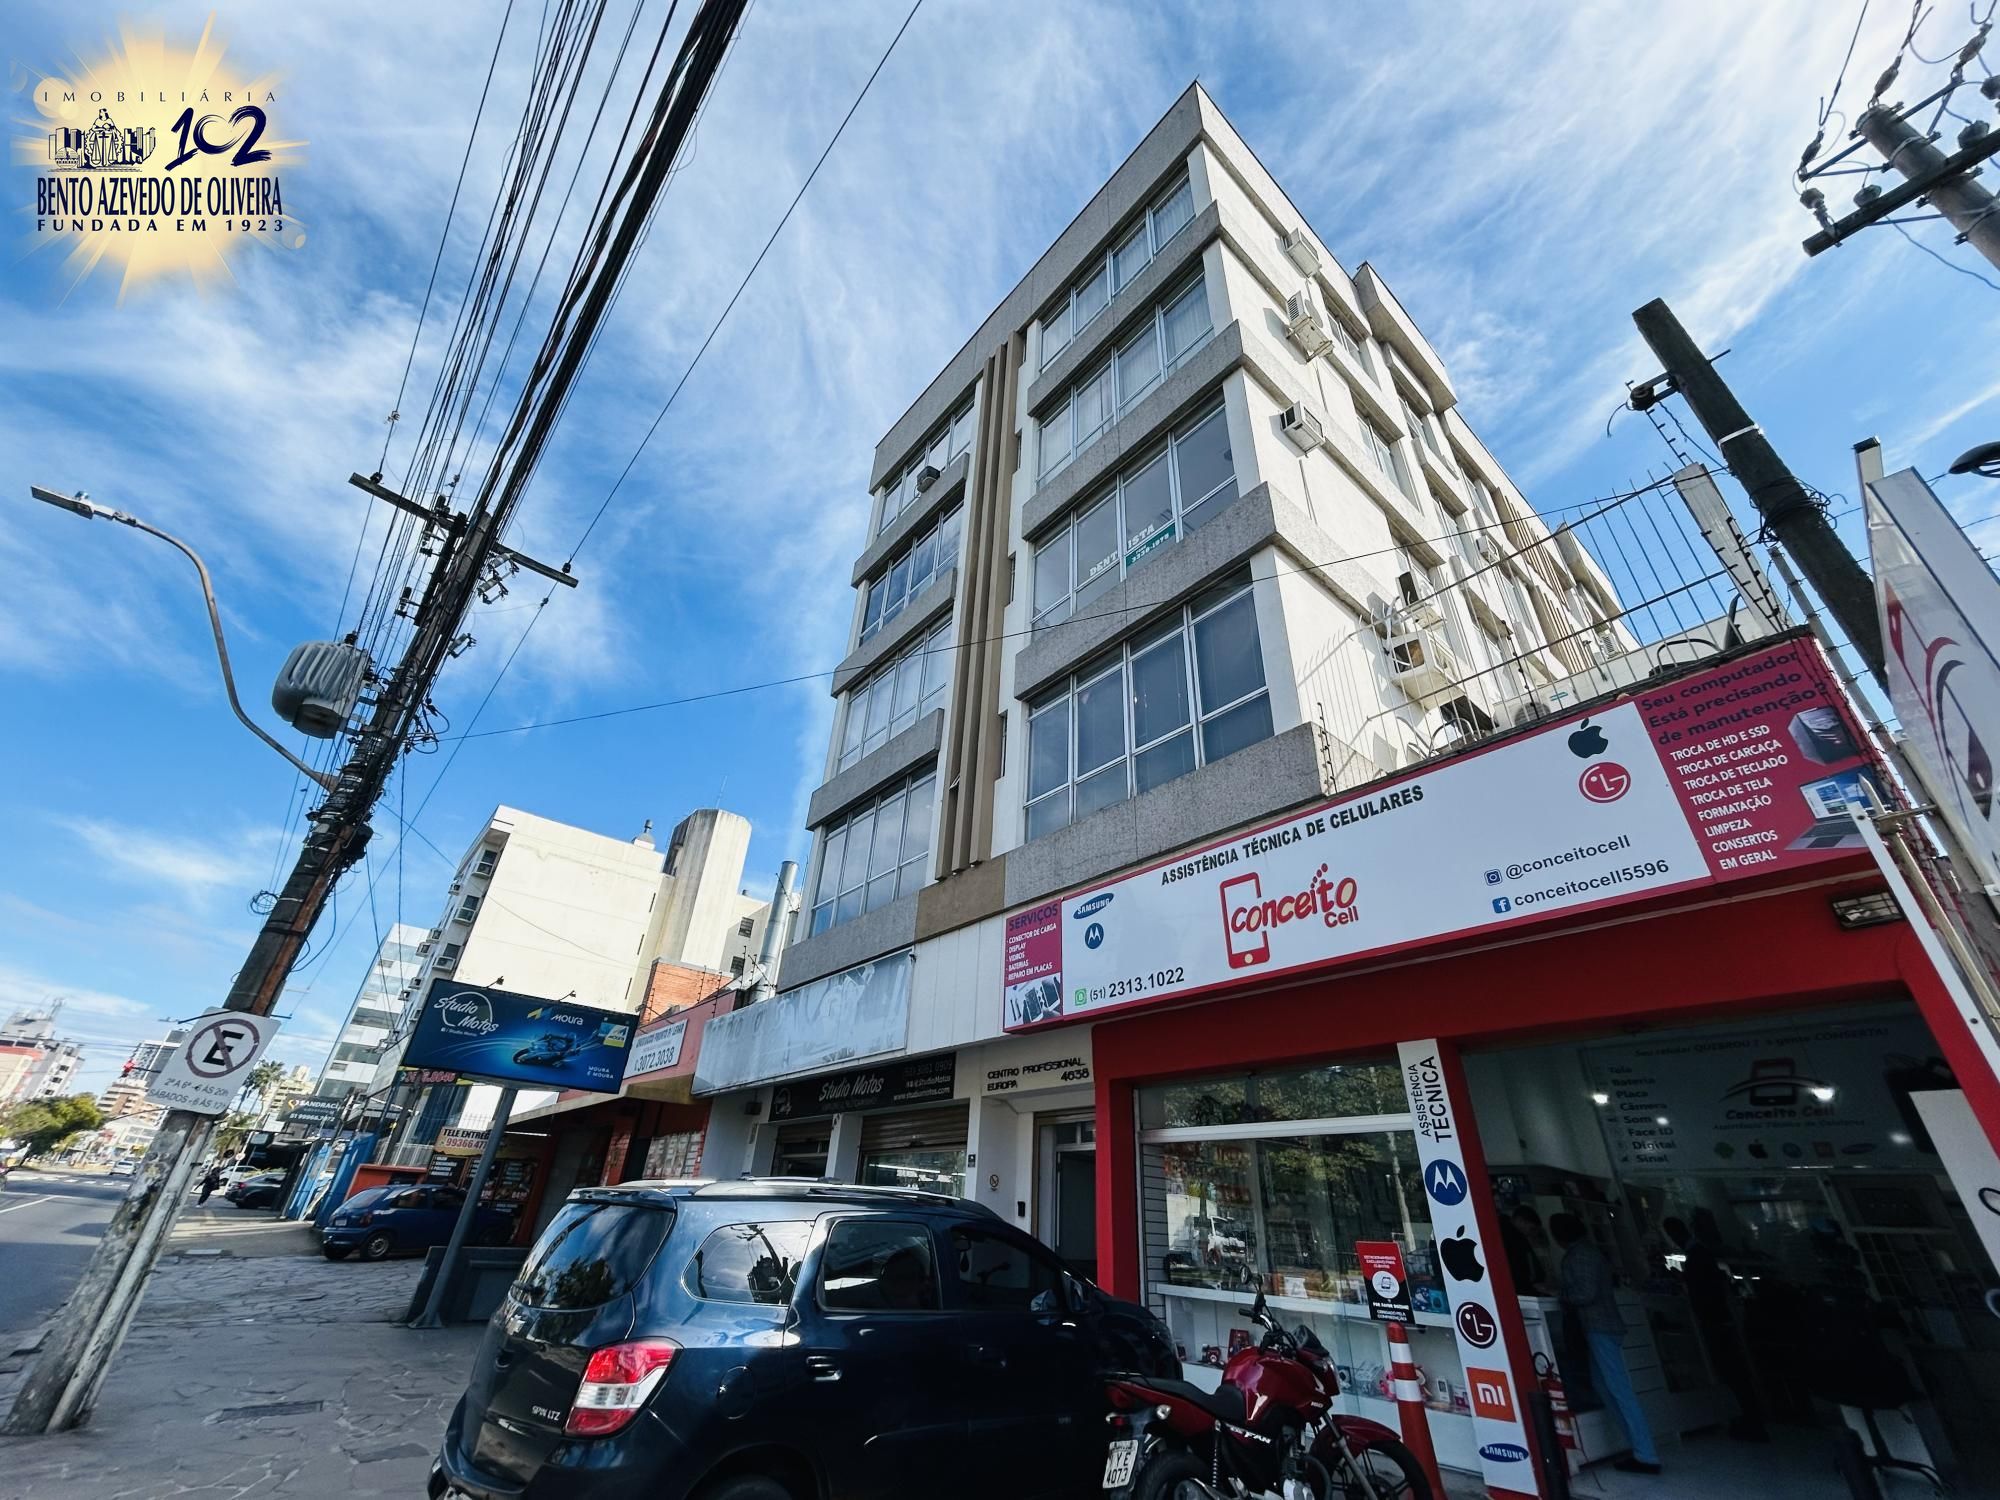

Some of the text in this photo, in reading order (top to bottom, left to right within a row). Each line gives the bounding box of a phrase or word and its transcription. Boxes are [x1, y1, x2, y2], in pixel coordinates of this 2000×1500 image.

[1642, 651, 1800, 711] Seu computador
[1650, 671, 1802, 728] Está precisando
[1658, 730, 1682, 745] de
[1670, 725, 1770, 761] TROCA DE HD E SSD
[1676, 739, 1782, 776] TROCA DE CARCAÇA
[1683, 754, 1788, 791] TROCA DE TECLADO
[1690, 777, 1773, 806] TROCA DE TELA
[1697, 795, 1772, 821] FORMATAÇÃO
[1161, 784, 1424, 885] ASSISTÊNCIA TÉCNICA DE CELULARES
[1704, 818, 1752, 837] LIMPEZA
[1712, 829, 1778, 853] CONSERTOS
[1506, 835, 1631, 879] @conceitocell
[1719, 849, 1777, 870] EM GERAL
[1514, 859, 1669, 906] conceitocell5596
[1077, 897, 1110, 915] SAMSUNG
[1009, 904, 1059, 931] SERVIÇOS
[1324, 906, 1359, 928] Cell
[1008, 922, 1057, 945] CONECTOR DE CARGA
[1008, 942, 1026, 954] DISPLAY
[1033, 961, 1053, 974] PLACAS
[1090, 966, 1185, 1003] (51) 2313.1022
[434, 998, 478, 1014] Studio
[457, 1016, 499, 1034] Motos
[202, 1029, 245, 1067] E
[588, 1065, 610, 1073] MOURA
[987, 1057, 1086, 1079] CENTRO PROFISSIONAL
[818, 1072, 884, 1102] Studio Motos
[987, 1080, 1018, 1091] EUROPA
[1611, 1076, 1657, 1087] Bateria
[1408, 1063, 1431, 1137] ASSISTÊNCIA
[1420, 1055, 1453, 1144] TÉCNICA
[1615, 1088, 1649, 1099] Placa
[1620, 1101, 1668, 1112] Câmera
[1726, 1105, 1836, 1121] Conceito Cell
[1623, 1115, 1652, 1125] Som
[443, 1129, 491, 1140] TELE ENTREG
[1628, 1126, 1674, 1138] Face ID
[1632, 1140, 1677, 1152] Digital
[1636, 1153, 1669, 1164] Sinal
[531, 1405, 561, 1421] SPIN LTZ
[1244, 1431, 1272, 1444] FAN
[1484, 1445, 1525, 1460] SAMSUNG
[1106, 1467, 1128, 1484] 4073
